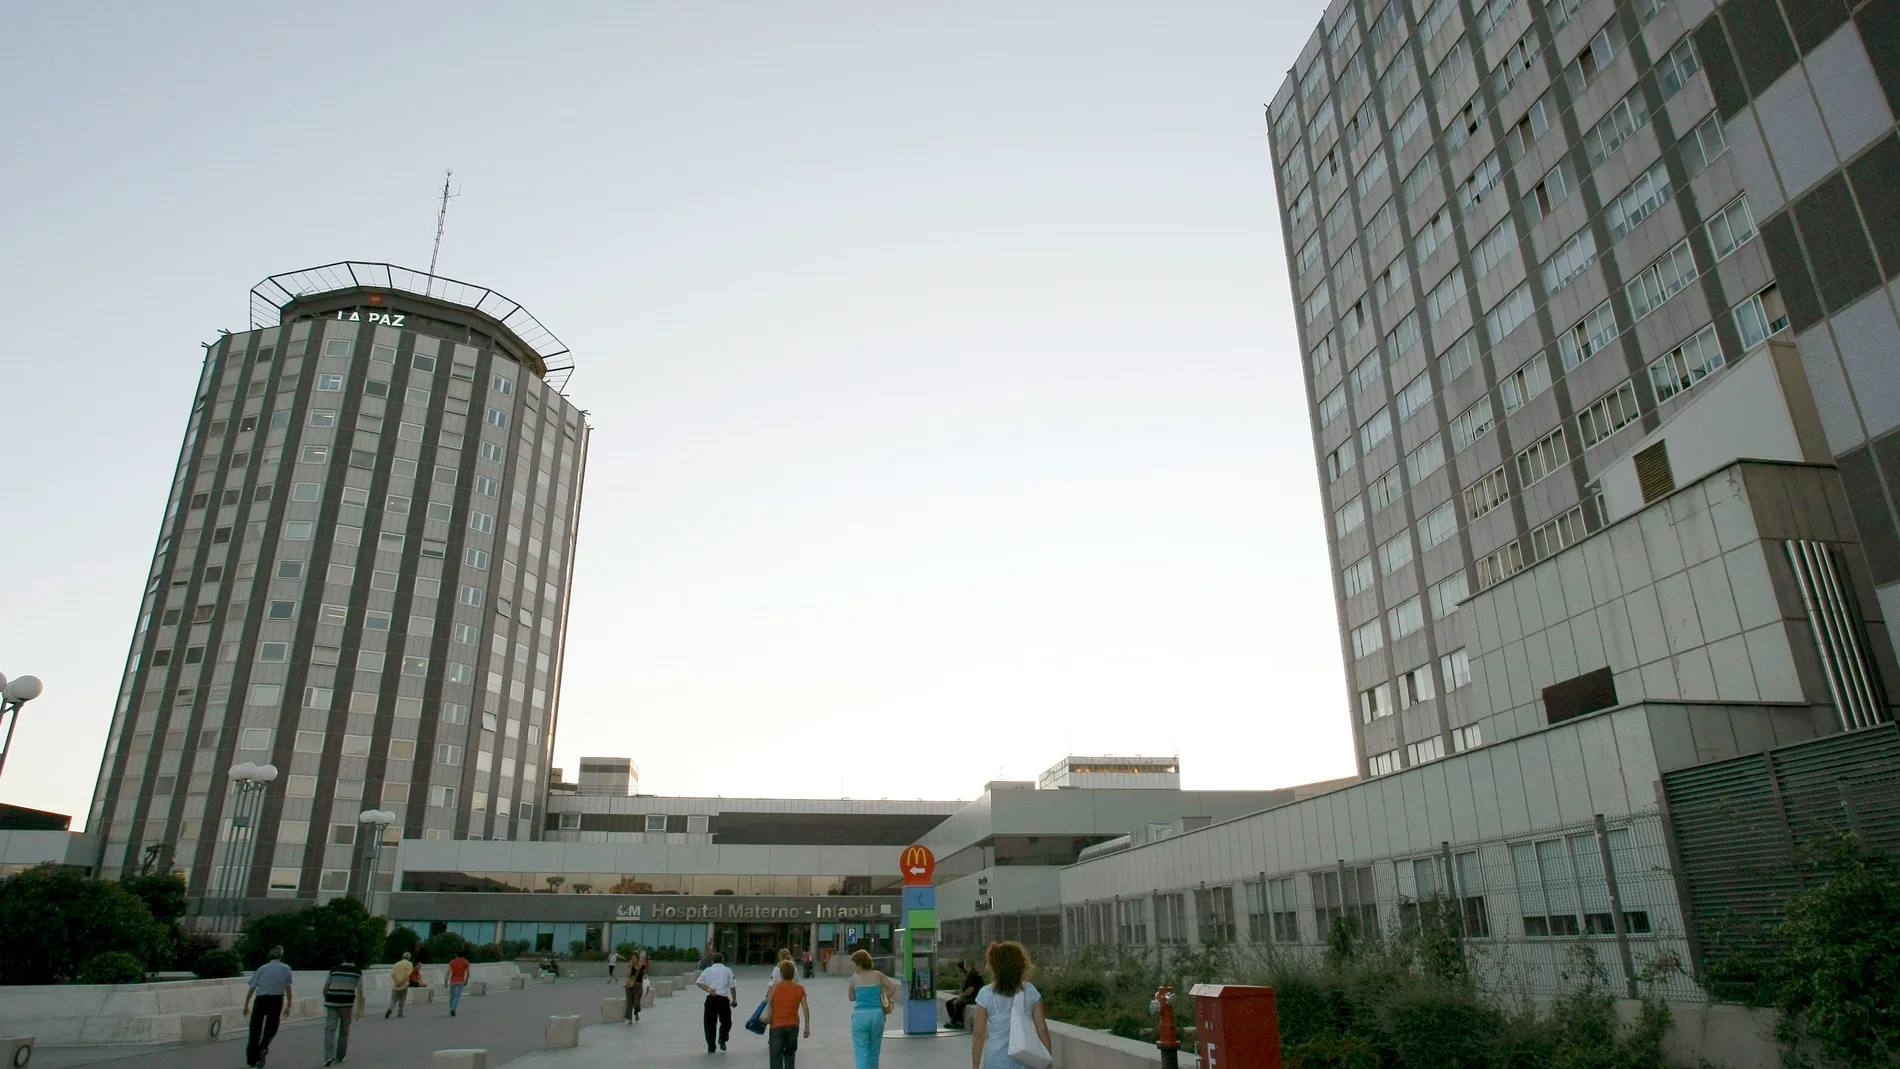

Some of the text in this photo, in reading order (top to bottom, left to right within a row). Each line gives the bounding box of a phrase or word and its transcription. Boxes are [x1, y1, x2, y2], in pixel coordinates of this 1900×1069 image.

[368, 312, 405, 326] PAZ
[652, 903, 723, 920] Hospital
[728, 903, 799, 919] Materno
[848, 928, 855, 937] P
